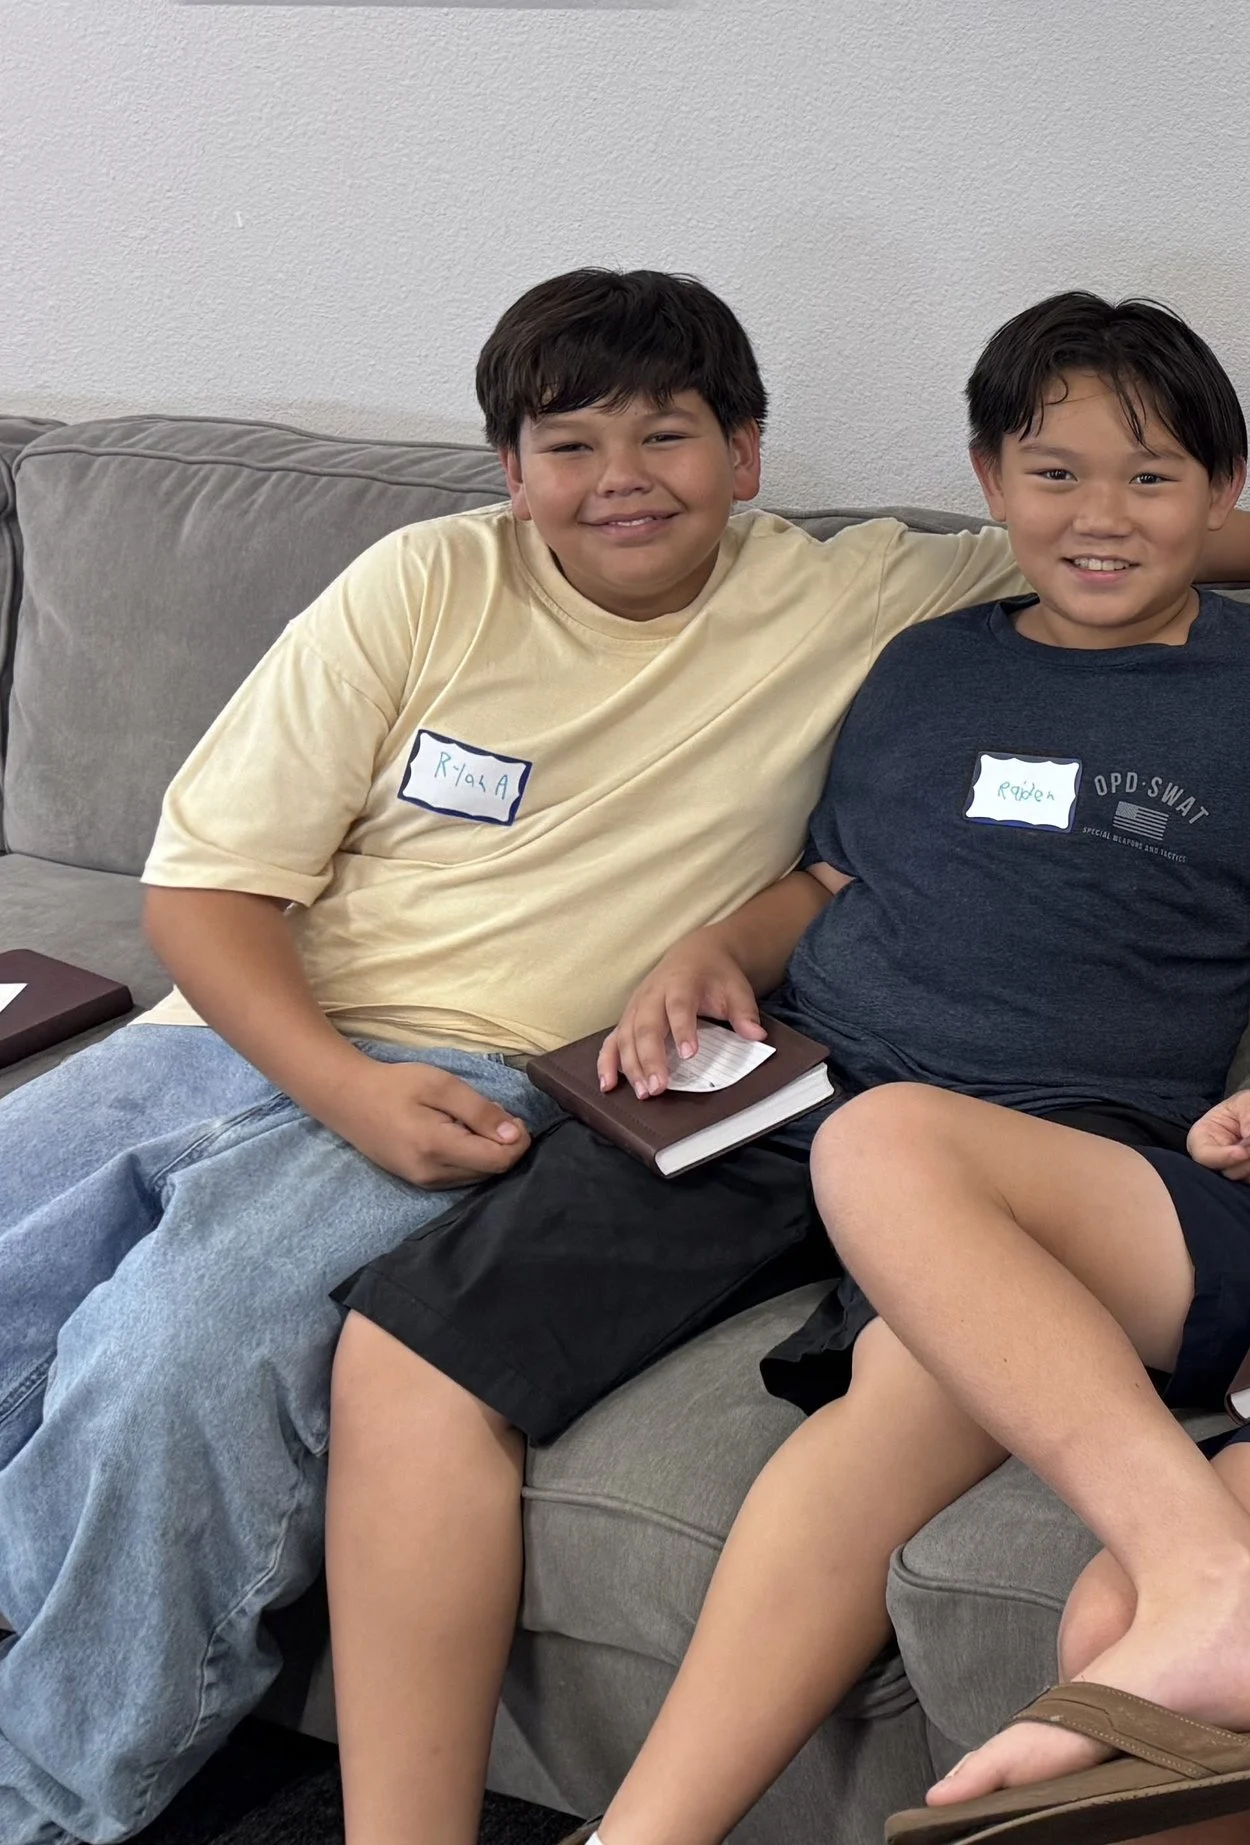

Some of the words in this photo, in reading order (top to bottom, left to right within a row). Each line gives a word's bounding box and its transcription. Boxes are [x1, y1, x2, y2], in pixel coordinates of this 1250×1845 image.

[494, 774, 509, 800] A
[1081, 826, 1111, 840] SPECIAL
[1112, 834, 1143, 850] WEAPONS
[1143, 844, 1159, 855] AND
[1159, 848, 1187, 863] TACTICS
